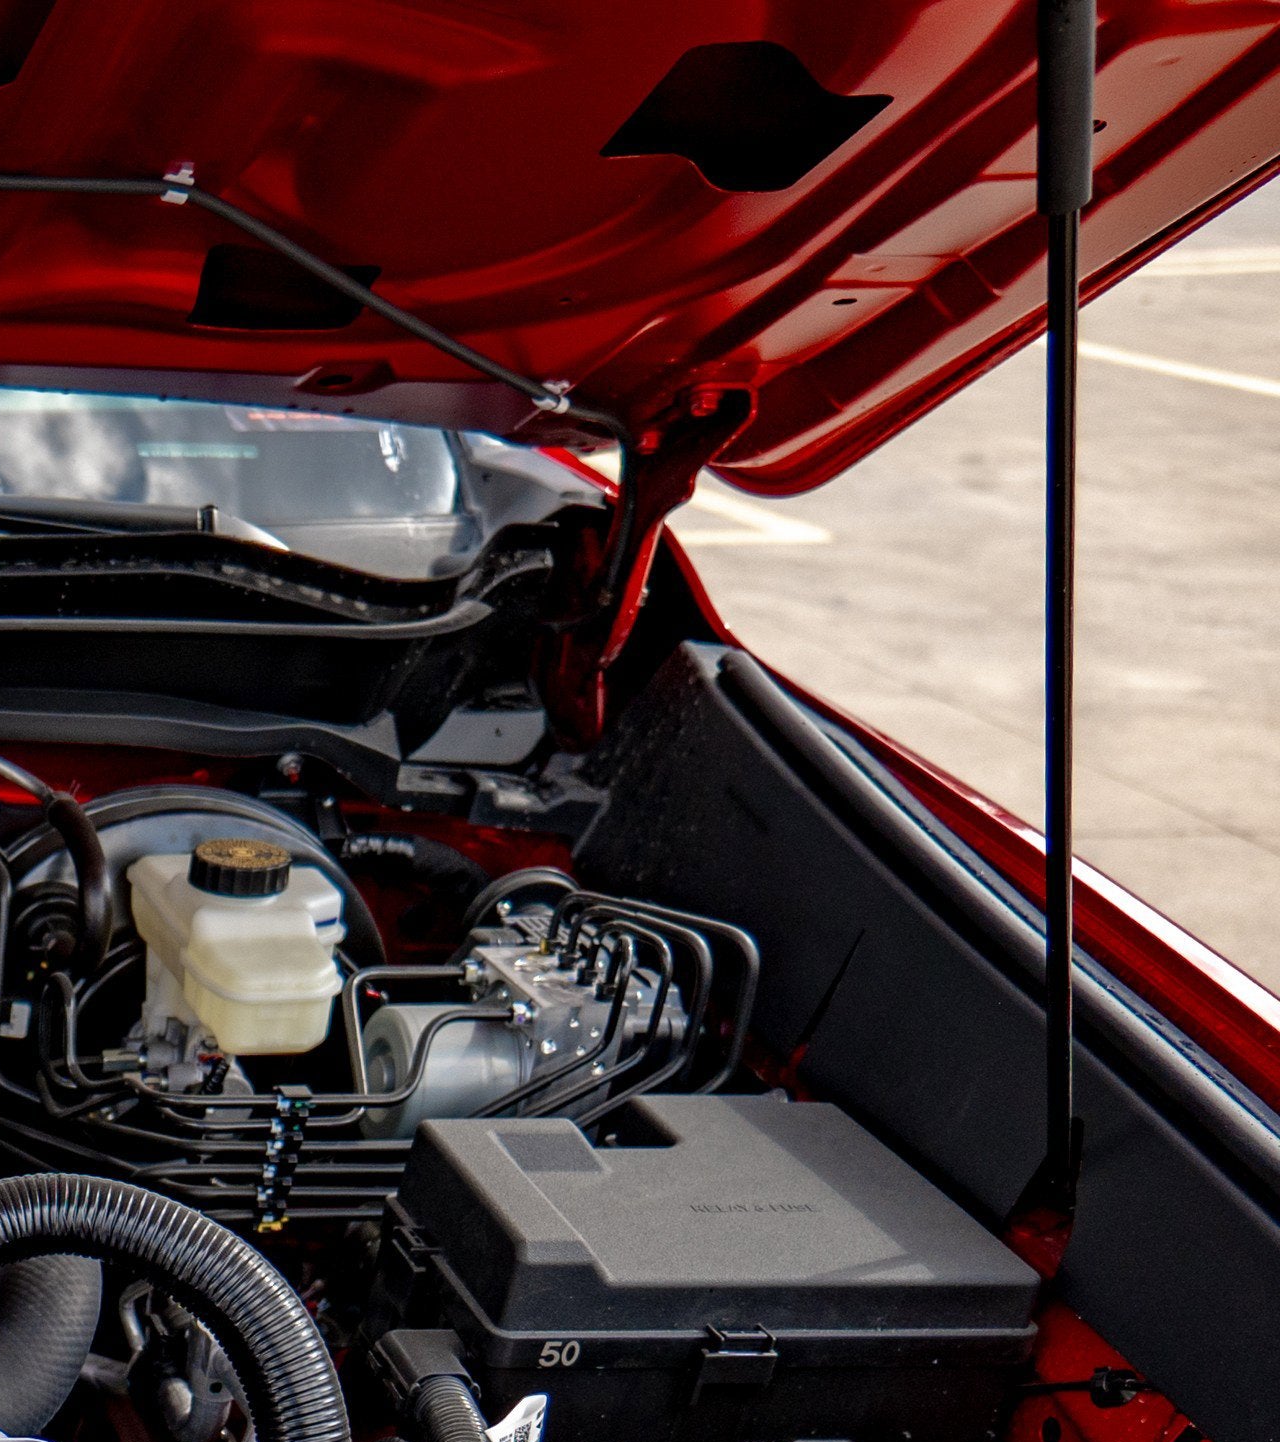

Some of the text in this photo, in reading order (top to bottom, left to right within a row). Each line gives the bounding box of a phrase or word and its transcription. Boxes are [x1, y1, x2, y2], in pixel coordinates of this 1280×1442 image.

[689, 1203, 749, 1213] RELAY
[768, 1203, 821, 1213] FUSE
[538, 1339, 581, 1368] 50
